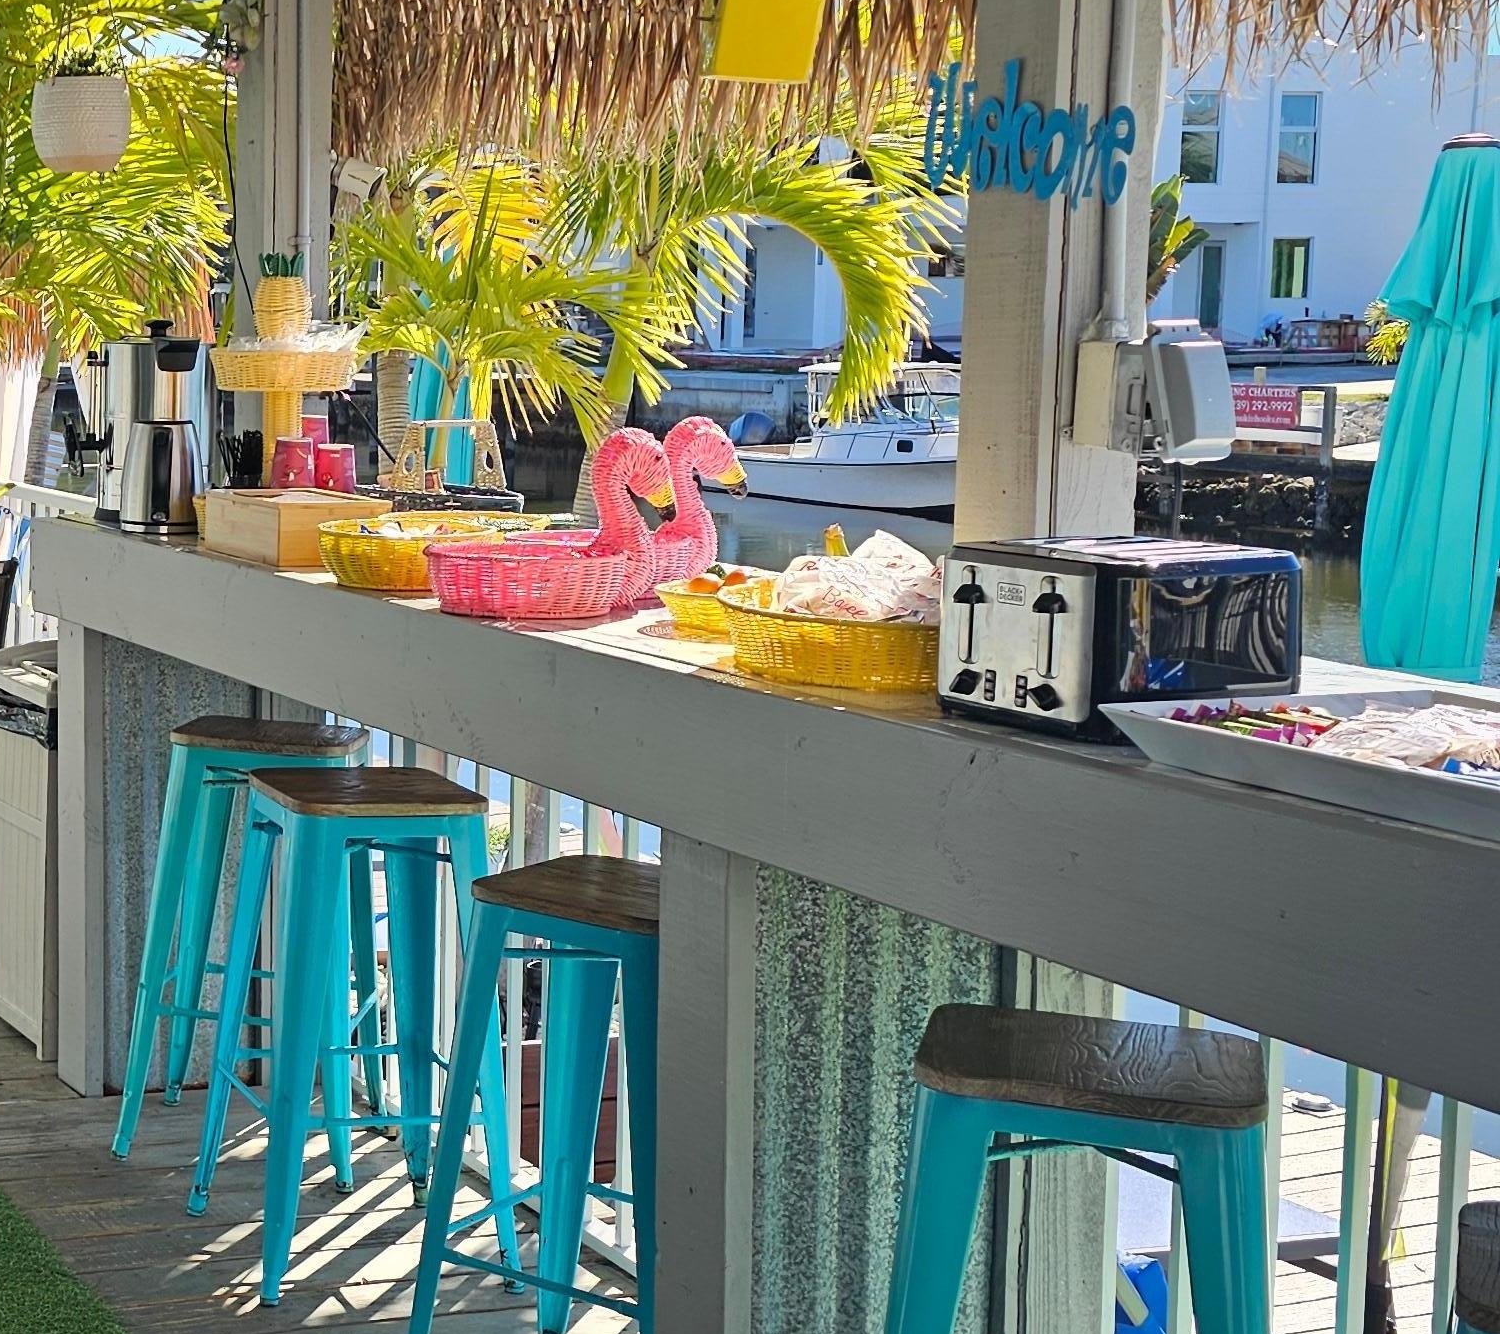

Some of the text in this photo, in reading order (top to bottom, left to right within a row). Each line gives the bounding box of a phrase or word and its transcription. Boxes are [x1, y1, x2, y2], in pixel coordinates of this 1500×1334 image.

[924, 58, 1135, 210] Welcome
[1232, 387, 1296, 397] NG CHARTERS
[1234, 399, 1293, 413] 39) 292-9992
[999, 593, 1023, 603] DECKER
